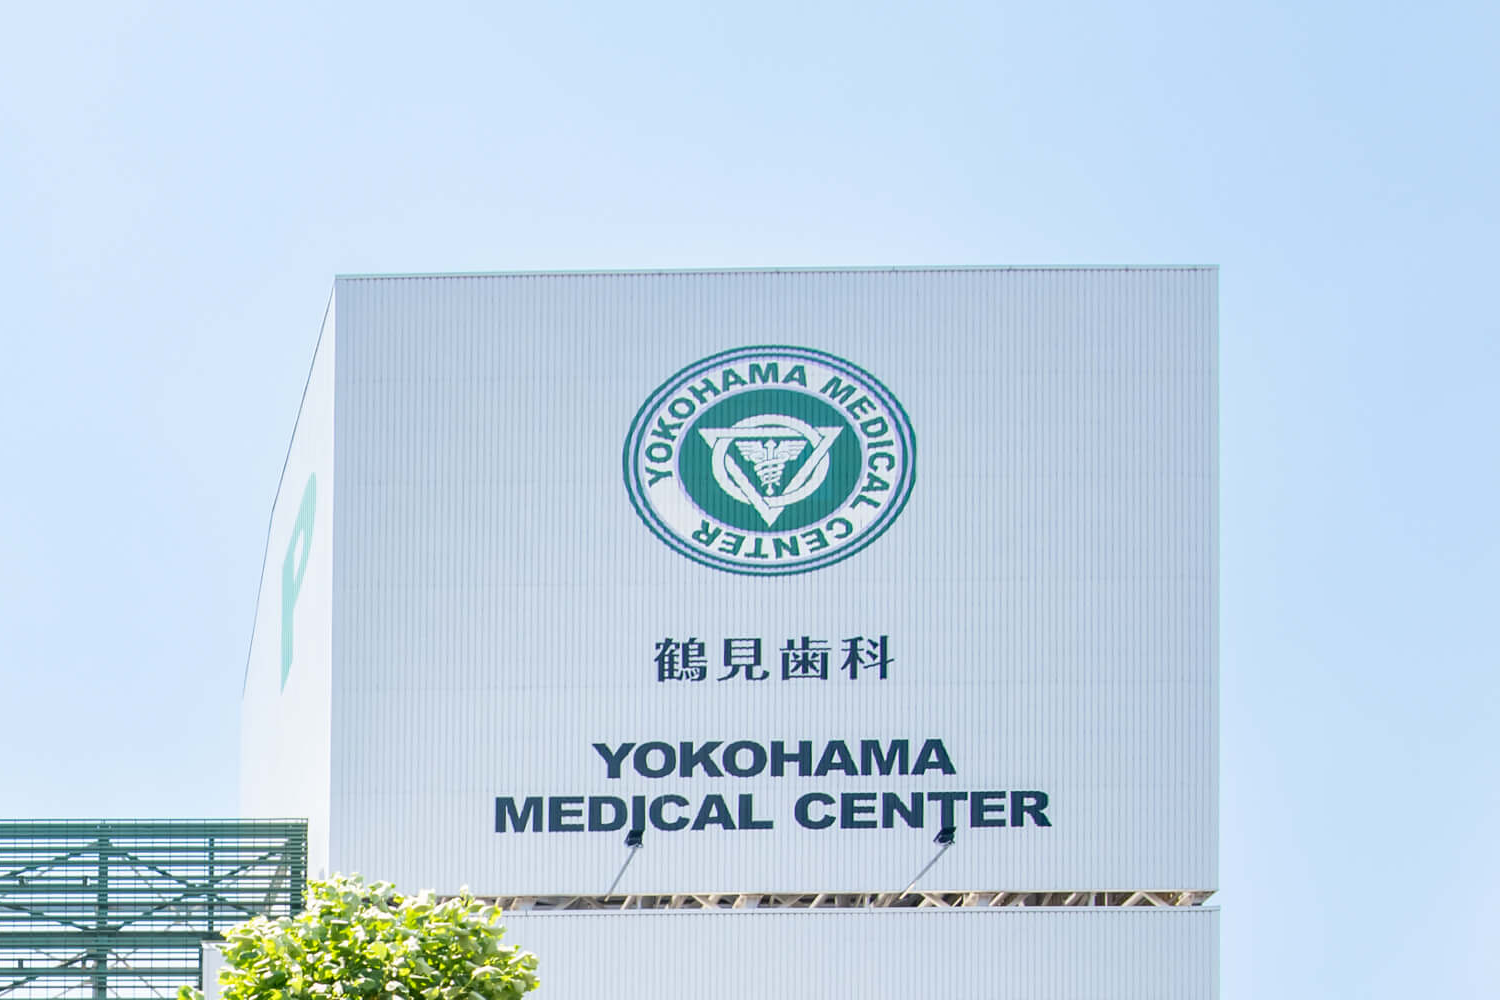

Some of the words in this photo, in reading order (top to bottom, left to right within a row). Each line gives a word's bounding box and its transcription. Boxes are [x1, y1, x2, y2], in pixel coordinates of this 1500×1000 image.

[646, 362, 808, 488] YOKOHAMA
[820, 375, 896, 512] MEDICAL
[692, 516, 855, 560] CENTER
[653, 635, 896, 682] 鶴見歯科
[592, 739, 957, 779] YOKOHAMA
[495, 794, 774, 833] MEDICAL
[794, 790, 1053, 831] CENTER
